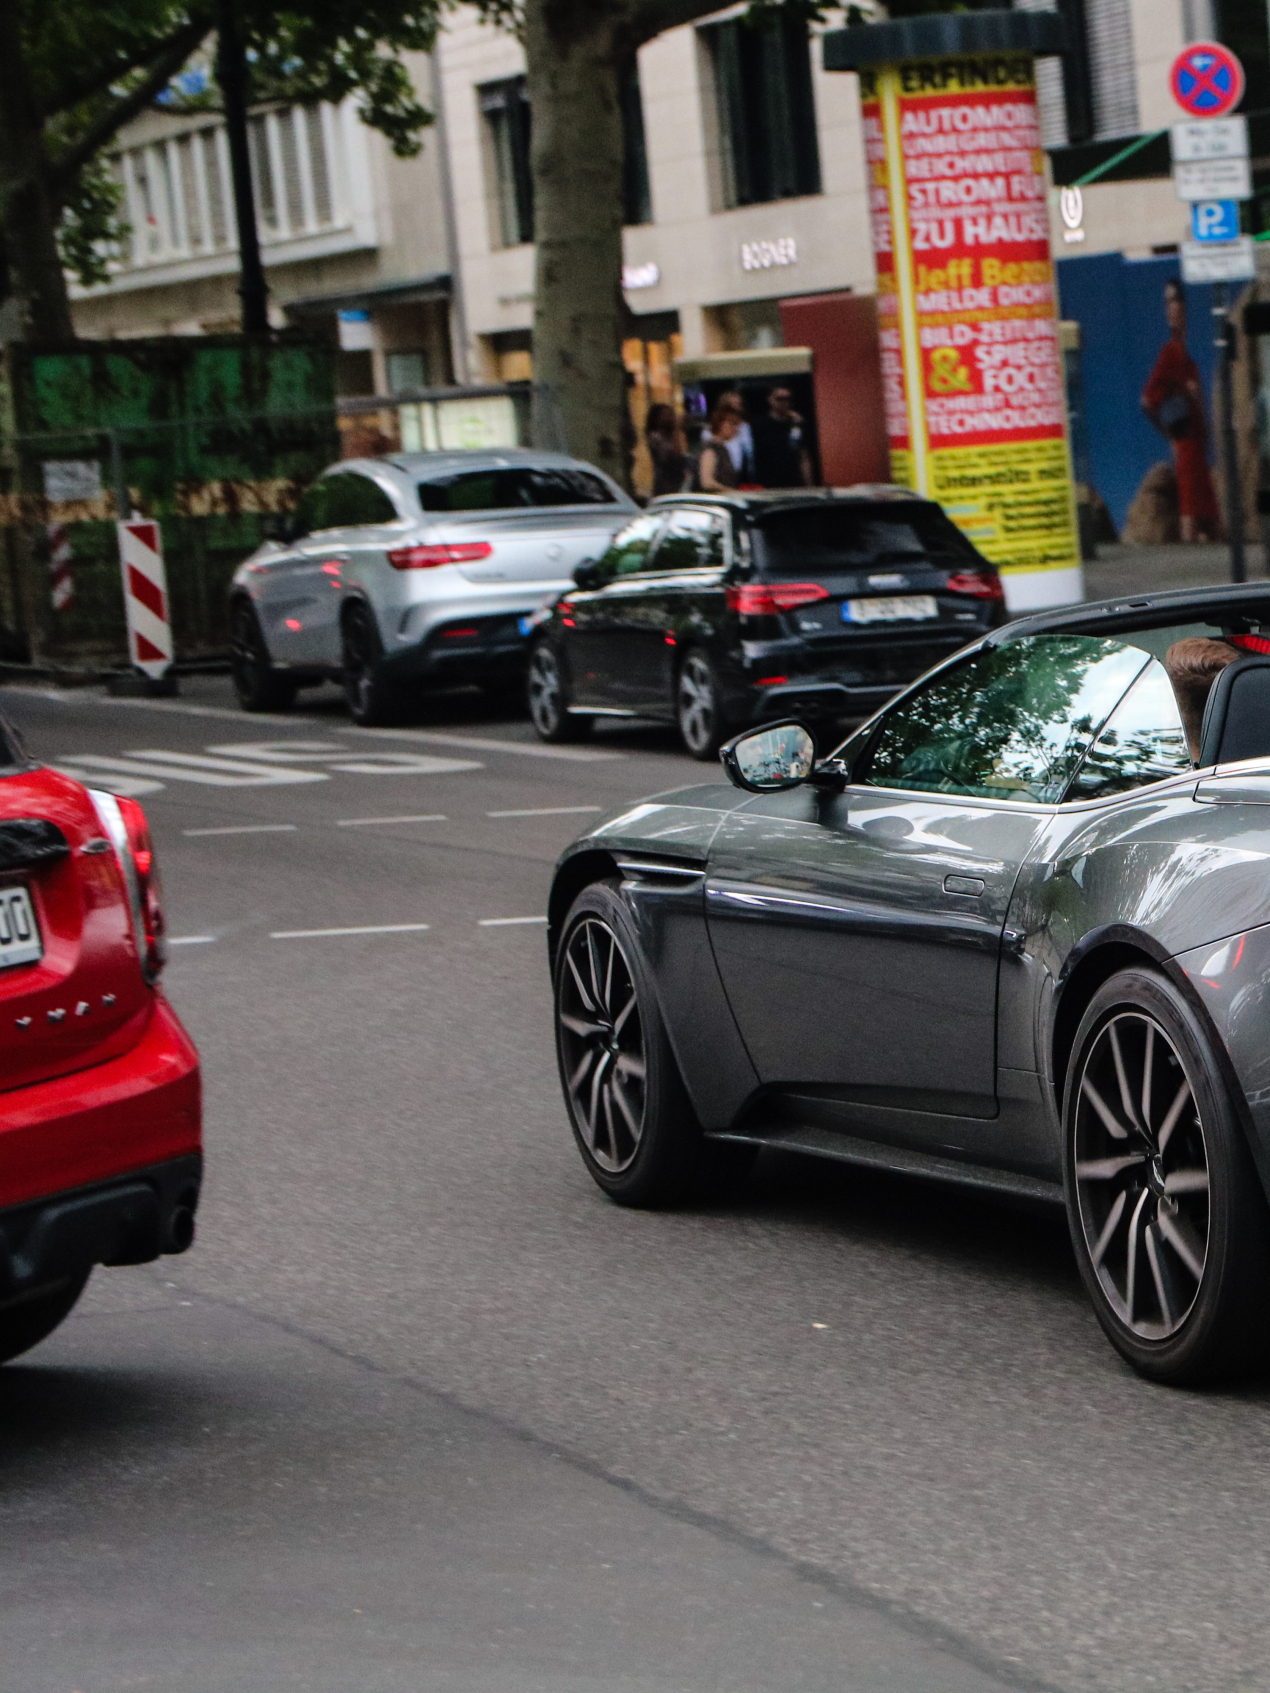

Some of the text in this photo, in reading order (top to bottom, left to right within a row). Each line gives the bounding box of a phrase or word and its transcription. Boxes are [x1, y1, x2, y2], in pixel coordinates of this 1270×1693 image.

[909, 177, 1006, 208] STROM
[913, 218, 955, 250] ZU
[916, 258, 974, 293] Jeff
[916, 287, 993, 314] MELDE
[929, 346, 974, 393] &
